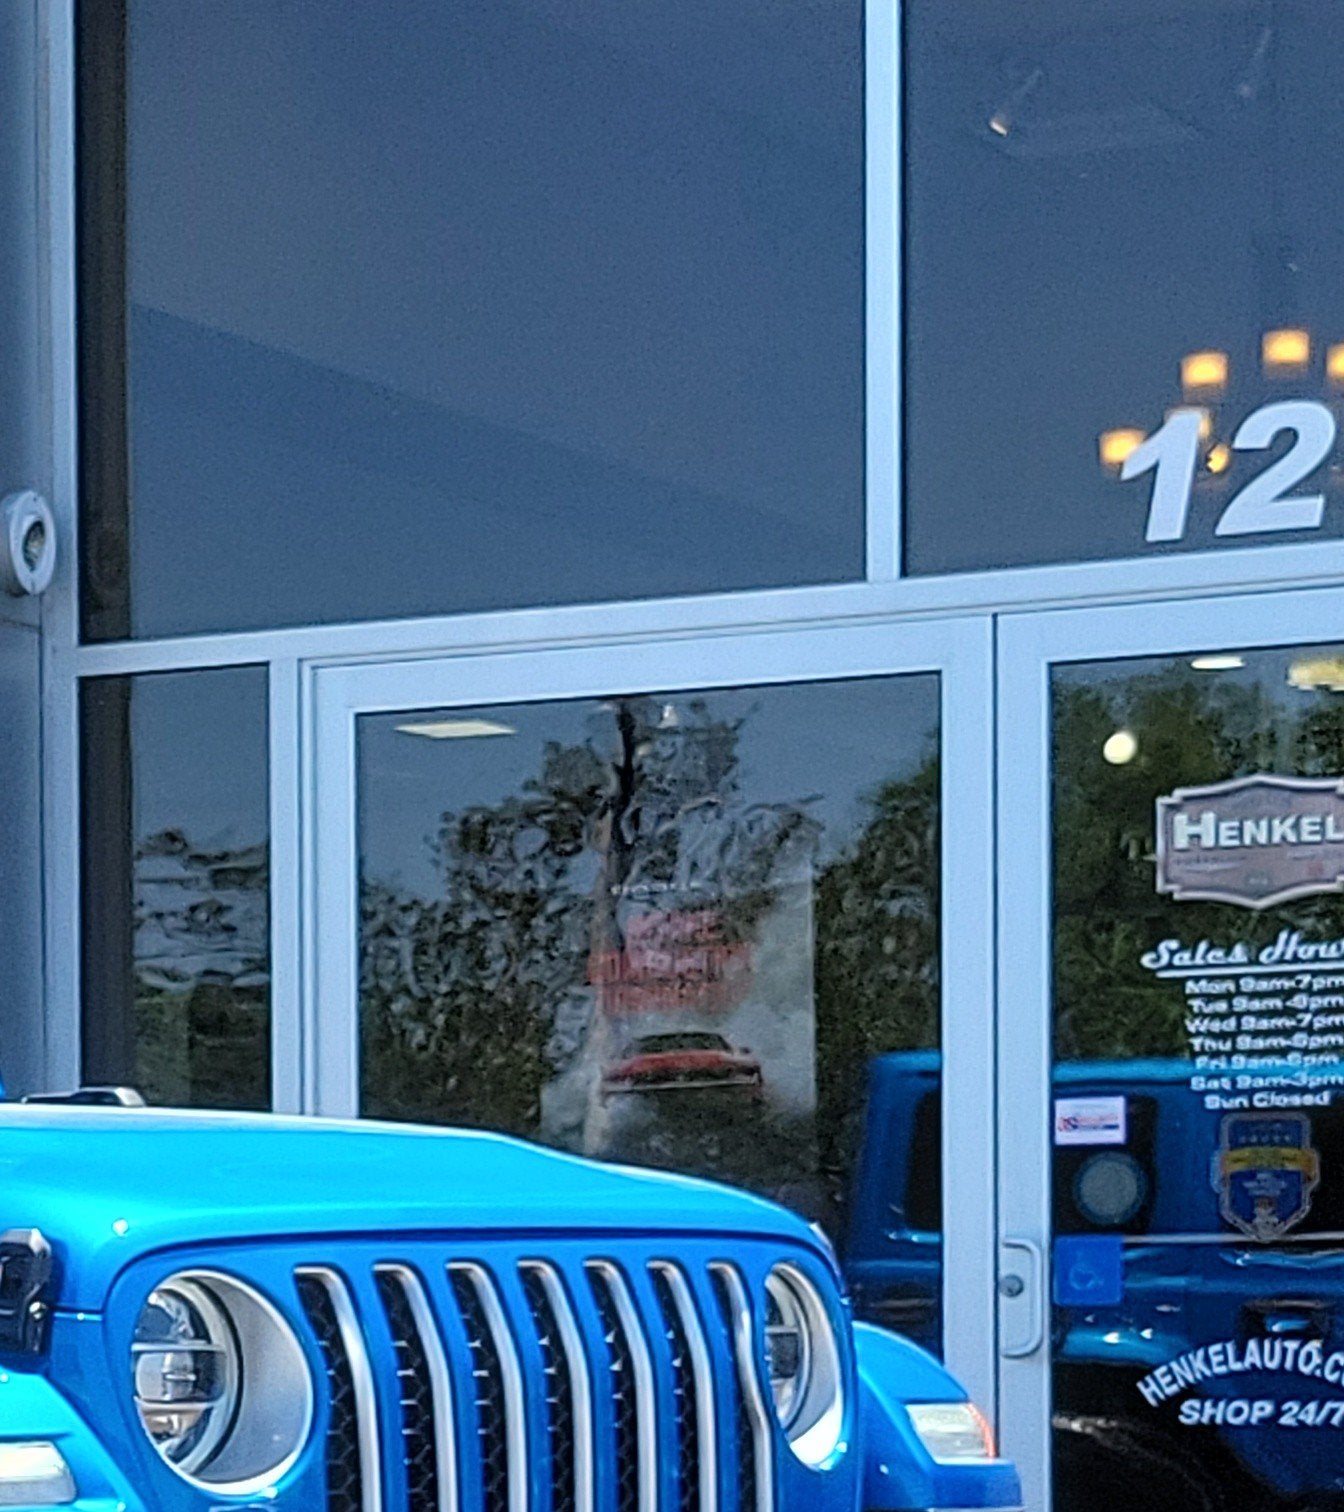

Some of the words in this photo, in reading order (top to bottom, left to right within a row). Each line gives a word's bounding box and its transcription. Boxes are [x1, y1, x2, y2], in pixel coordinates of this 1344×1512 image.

[1121, 400, 1335, 542] 12
[1173, 810, 1344, 850] HENKEL
[1140, 938, 1249, 969] Sales
[1259, 928, 1344, 963] Hou
[1185, 978, 1235, 994] Mon
[1188, 998, 1228, 1014] Tue
[1185, 1016, 1236, 1033] Wed
[1190, 1036, 1232, 1052] Thu
[1196, 1055, 1227, 1070] Fri
[1190, 1076, 1232, 1091] Sat
[1204, 1095, 1249, 1109] Sun
[1252, 1091, 1330, 1107] Closed
[1135, 1337, 1344, 1407] HENKELAUTO.C
[1178, 1398, 1274, 1426] SHOP
[1277, 1398, 1344, 1426] 24/7
